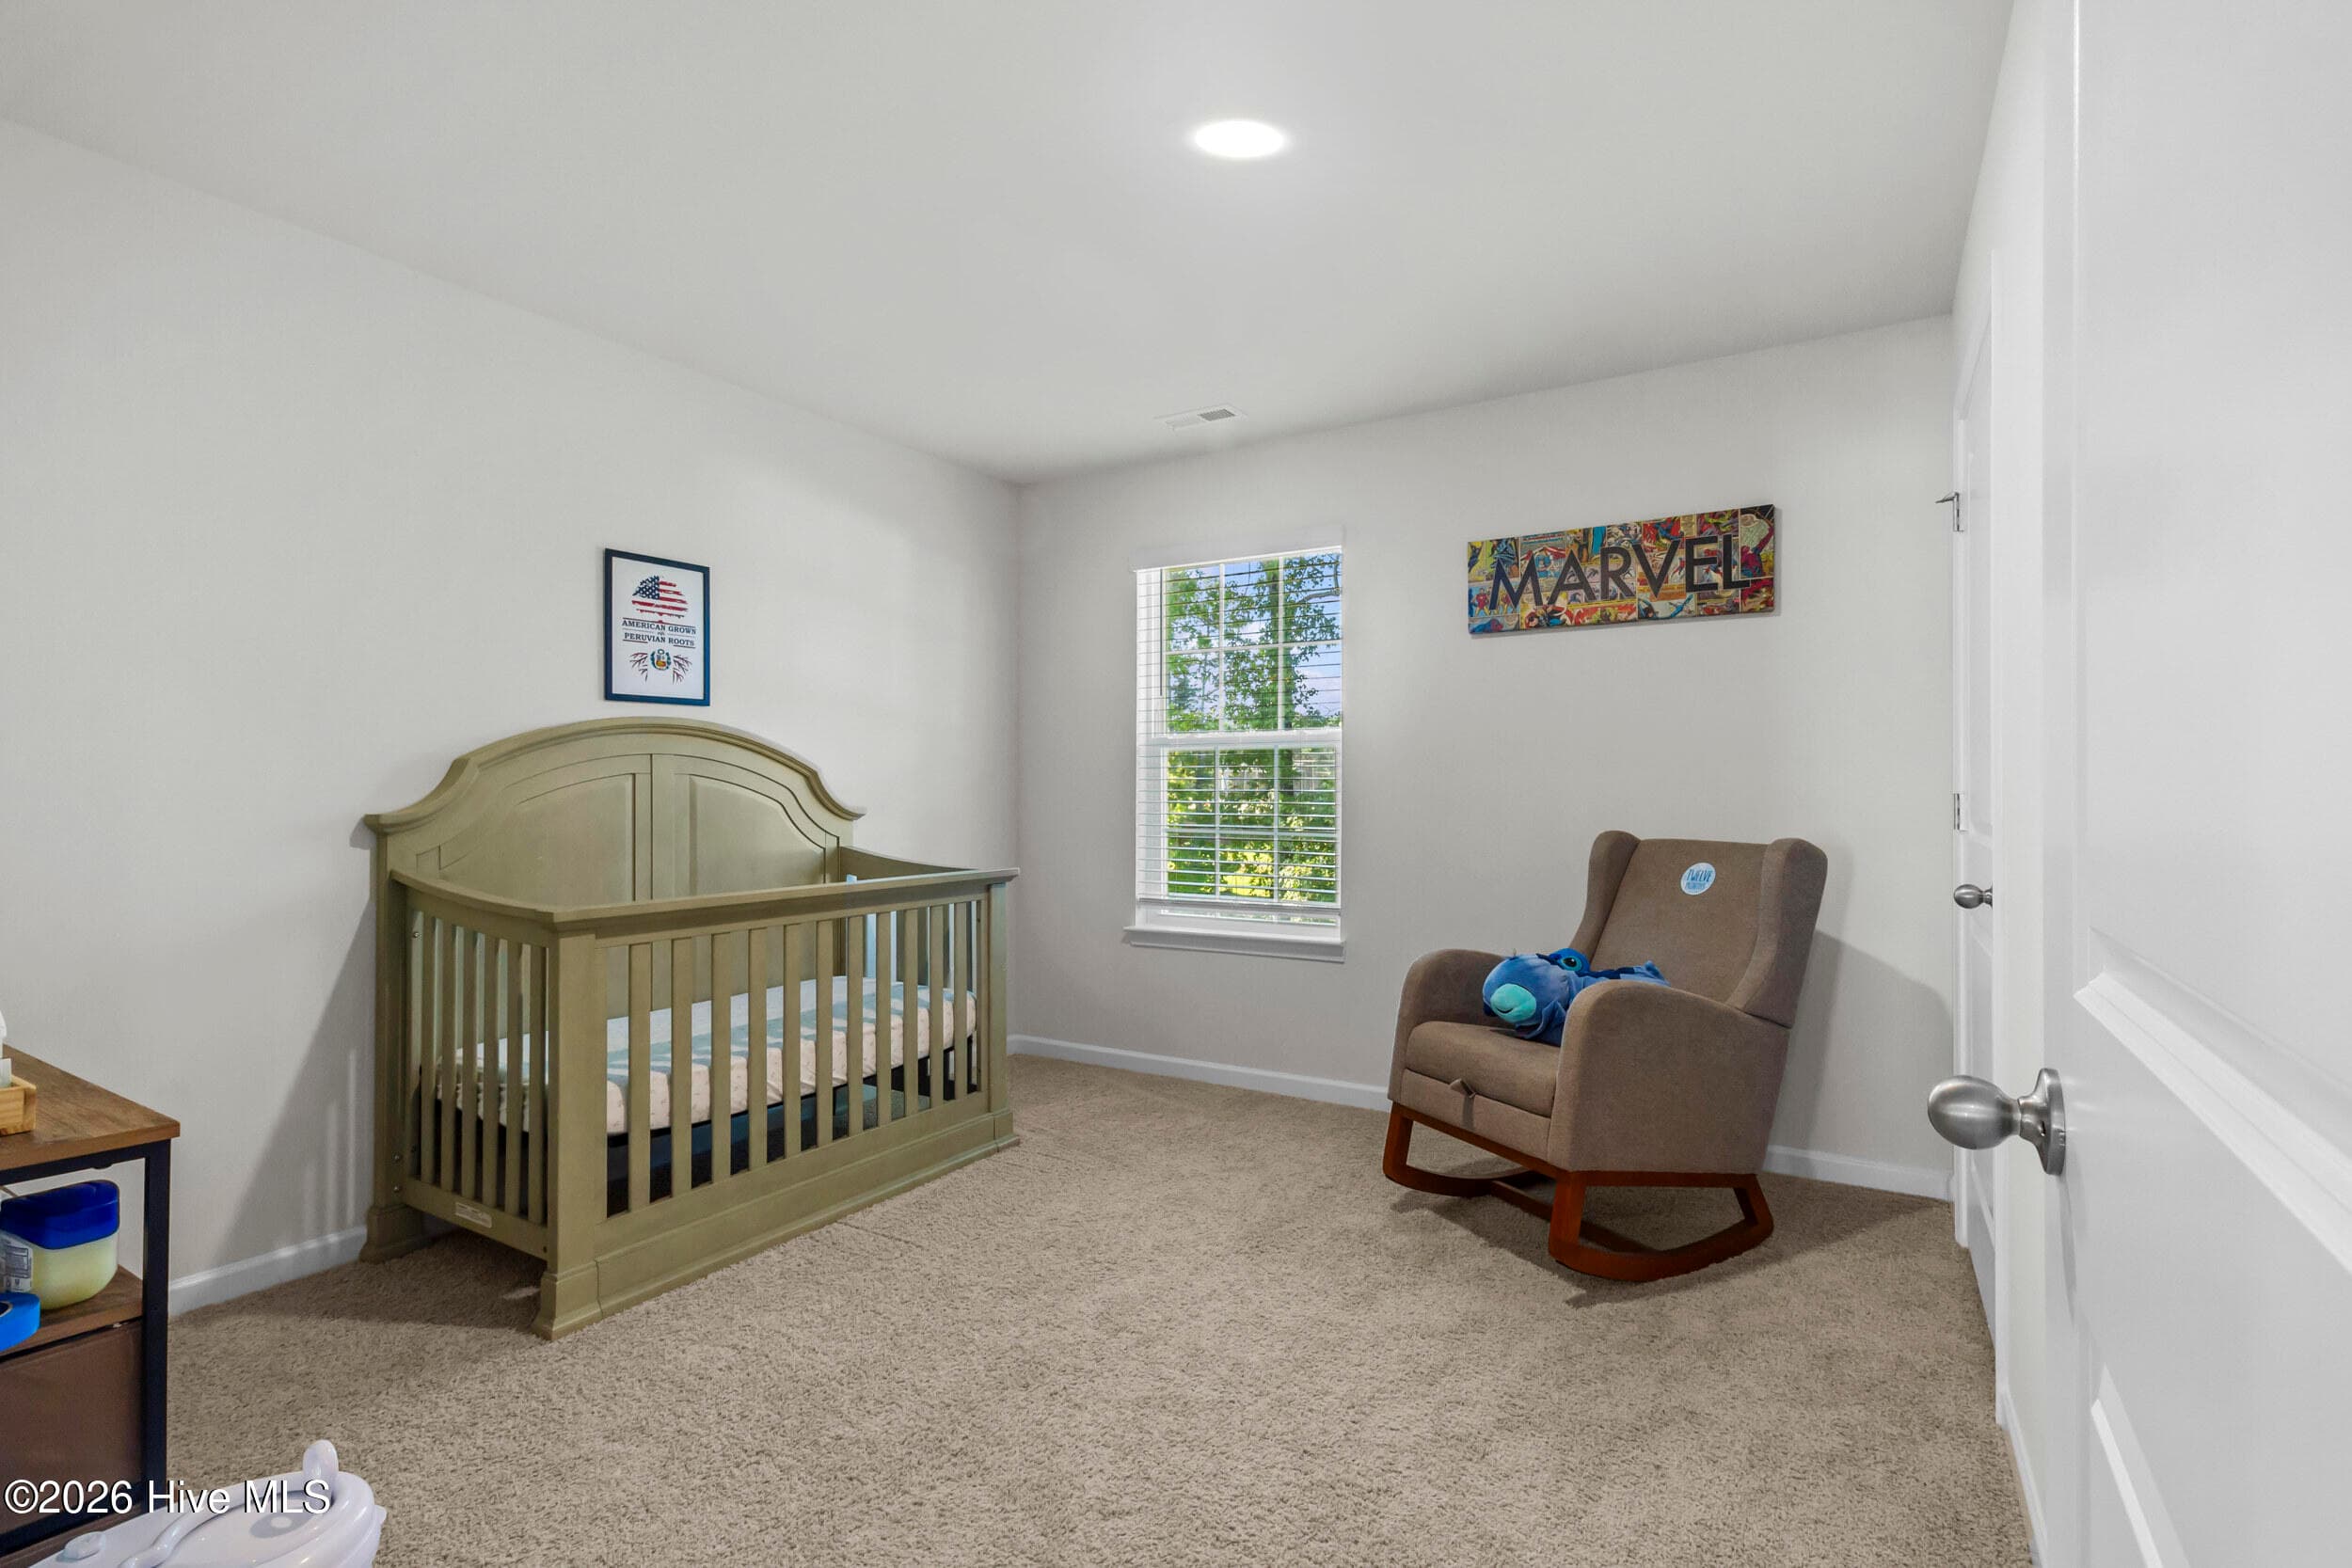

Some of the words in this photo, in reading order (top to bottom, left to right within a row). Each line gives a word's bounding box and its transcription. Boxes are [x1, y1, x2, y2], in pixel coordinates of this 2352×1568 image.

[1488, 533, 1751, 610] MARVEL
[622, 620, 666, 631] AMERICAN
[668, 626, 696, 635] GROWN
[625, 632, 666, 642] PERUVIAN
[668, 638, 694, 646] ROOTS
